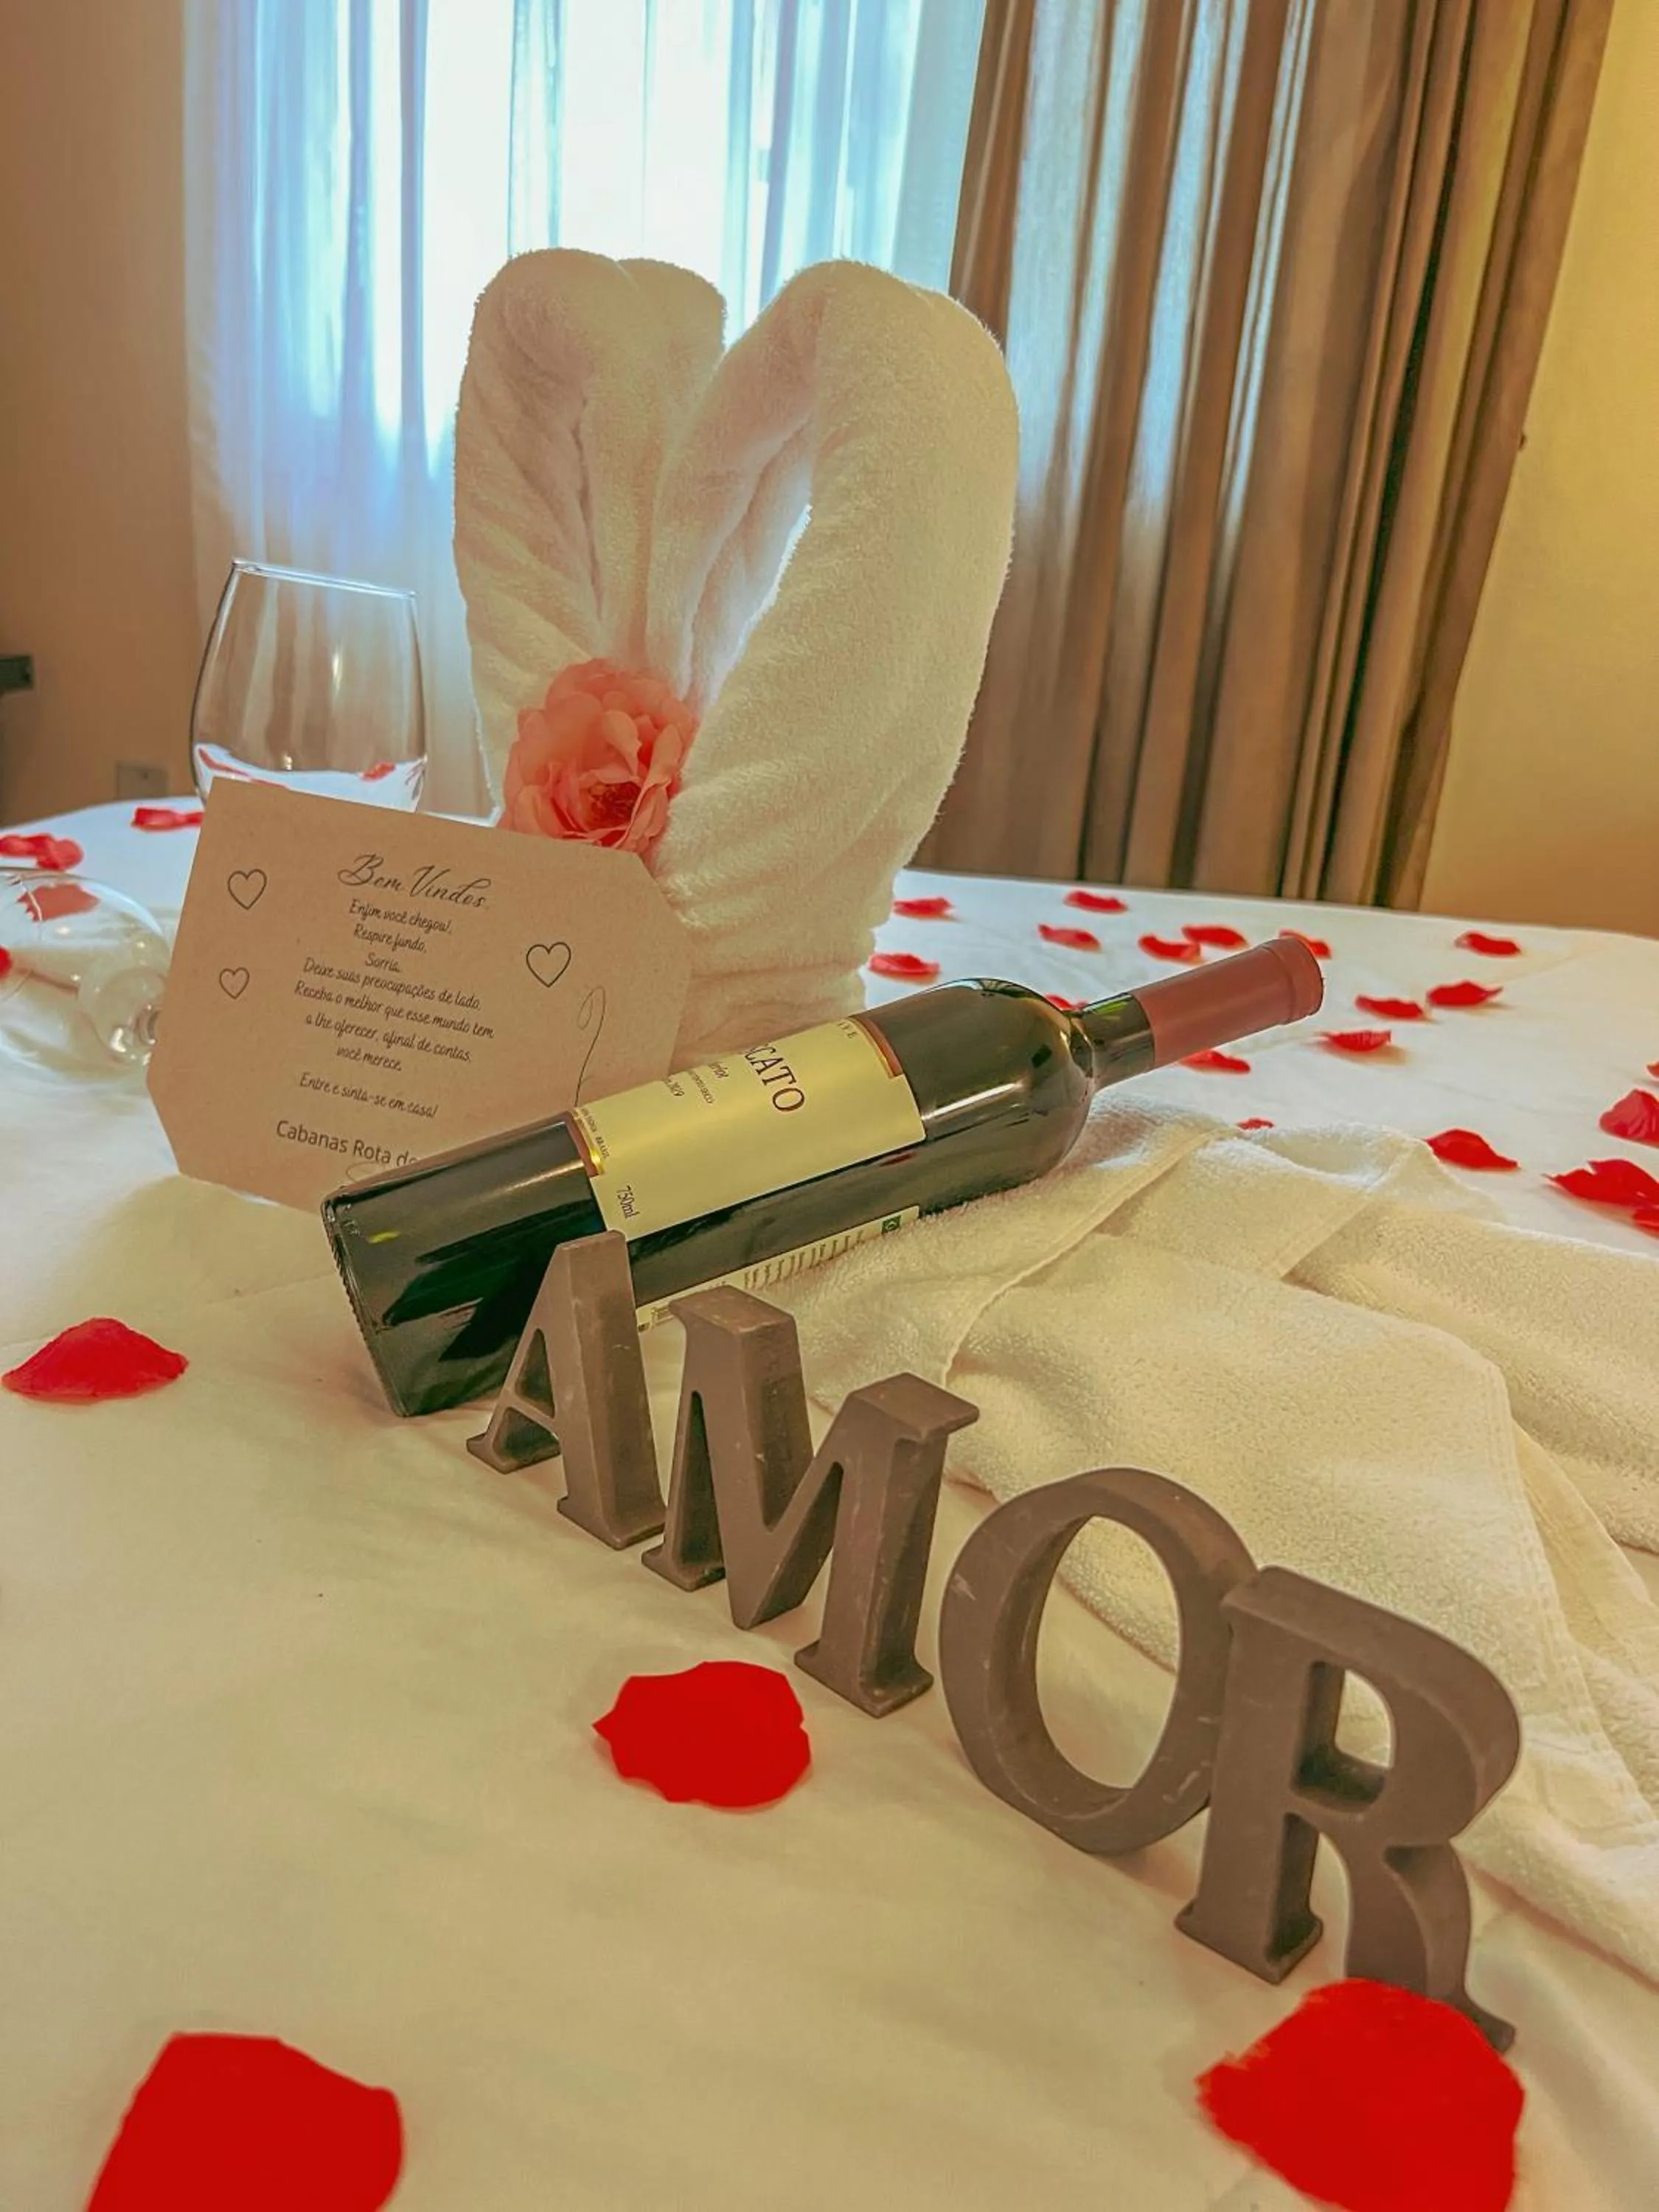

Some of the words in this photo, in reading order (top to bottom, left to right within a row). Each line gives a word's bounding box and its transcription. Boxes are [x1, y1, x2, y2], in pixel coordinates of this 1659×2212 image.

[338, 854, 403, 891] Bem
[349, 898, 381, 920] Enfim
[354, 923, 394, 945] Respire
[304, 957, 334, 978] Deixe
[335, 970, 360, 984] suas
[361, 975, 435, 1001] preocupações
[439, 990, 453, 1004] de
[294, 980, 333, 1002] Receba
[335, 992, 342, 1004] o
[344, 994, 383, 1012] melhor
[384, 1005, 404, 1020] que
[406, 1009, 431, 1024] esse
[432, 1015, 471, 1033] mundo
[473, 1021, 495, 1038] tem
[315, 1011, 333, 1029] lhe
[383, 1030, 416, 1048] afinal
[417, 1038, 431, 1052] de
[336, 1046, 361, 1061] você
[299, 1072, 331, 1093] Entre
[333, 1085, 340, 1095] e
[341, 1085, 387, 1106] sinta-se
[388, 1096, 406, 1111] em
[745, 1043, 804, 1112] CATO
[276, 1119, 349, 1154] Cabanas
[352, 1138, 392, 1164] Rota
[466, 1230, 1522, 2050] AMOR
